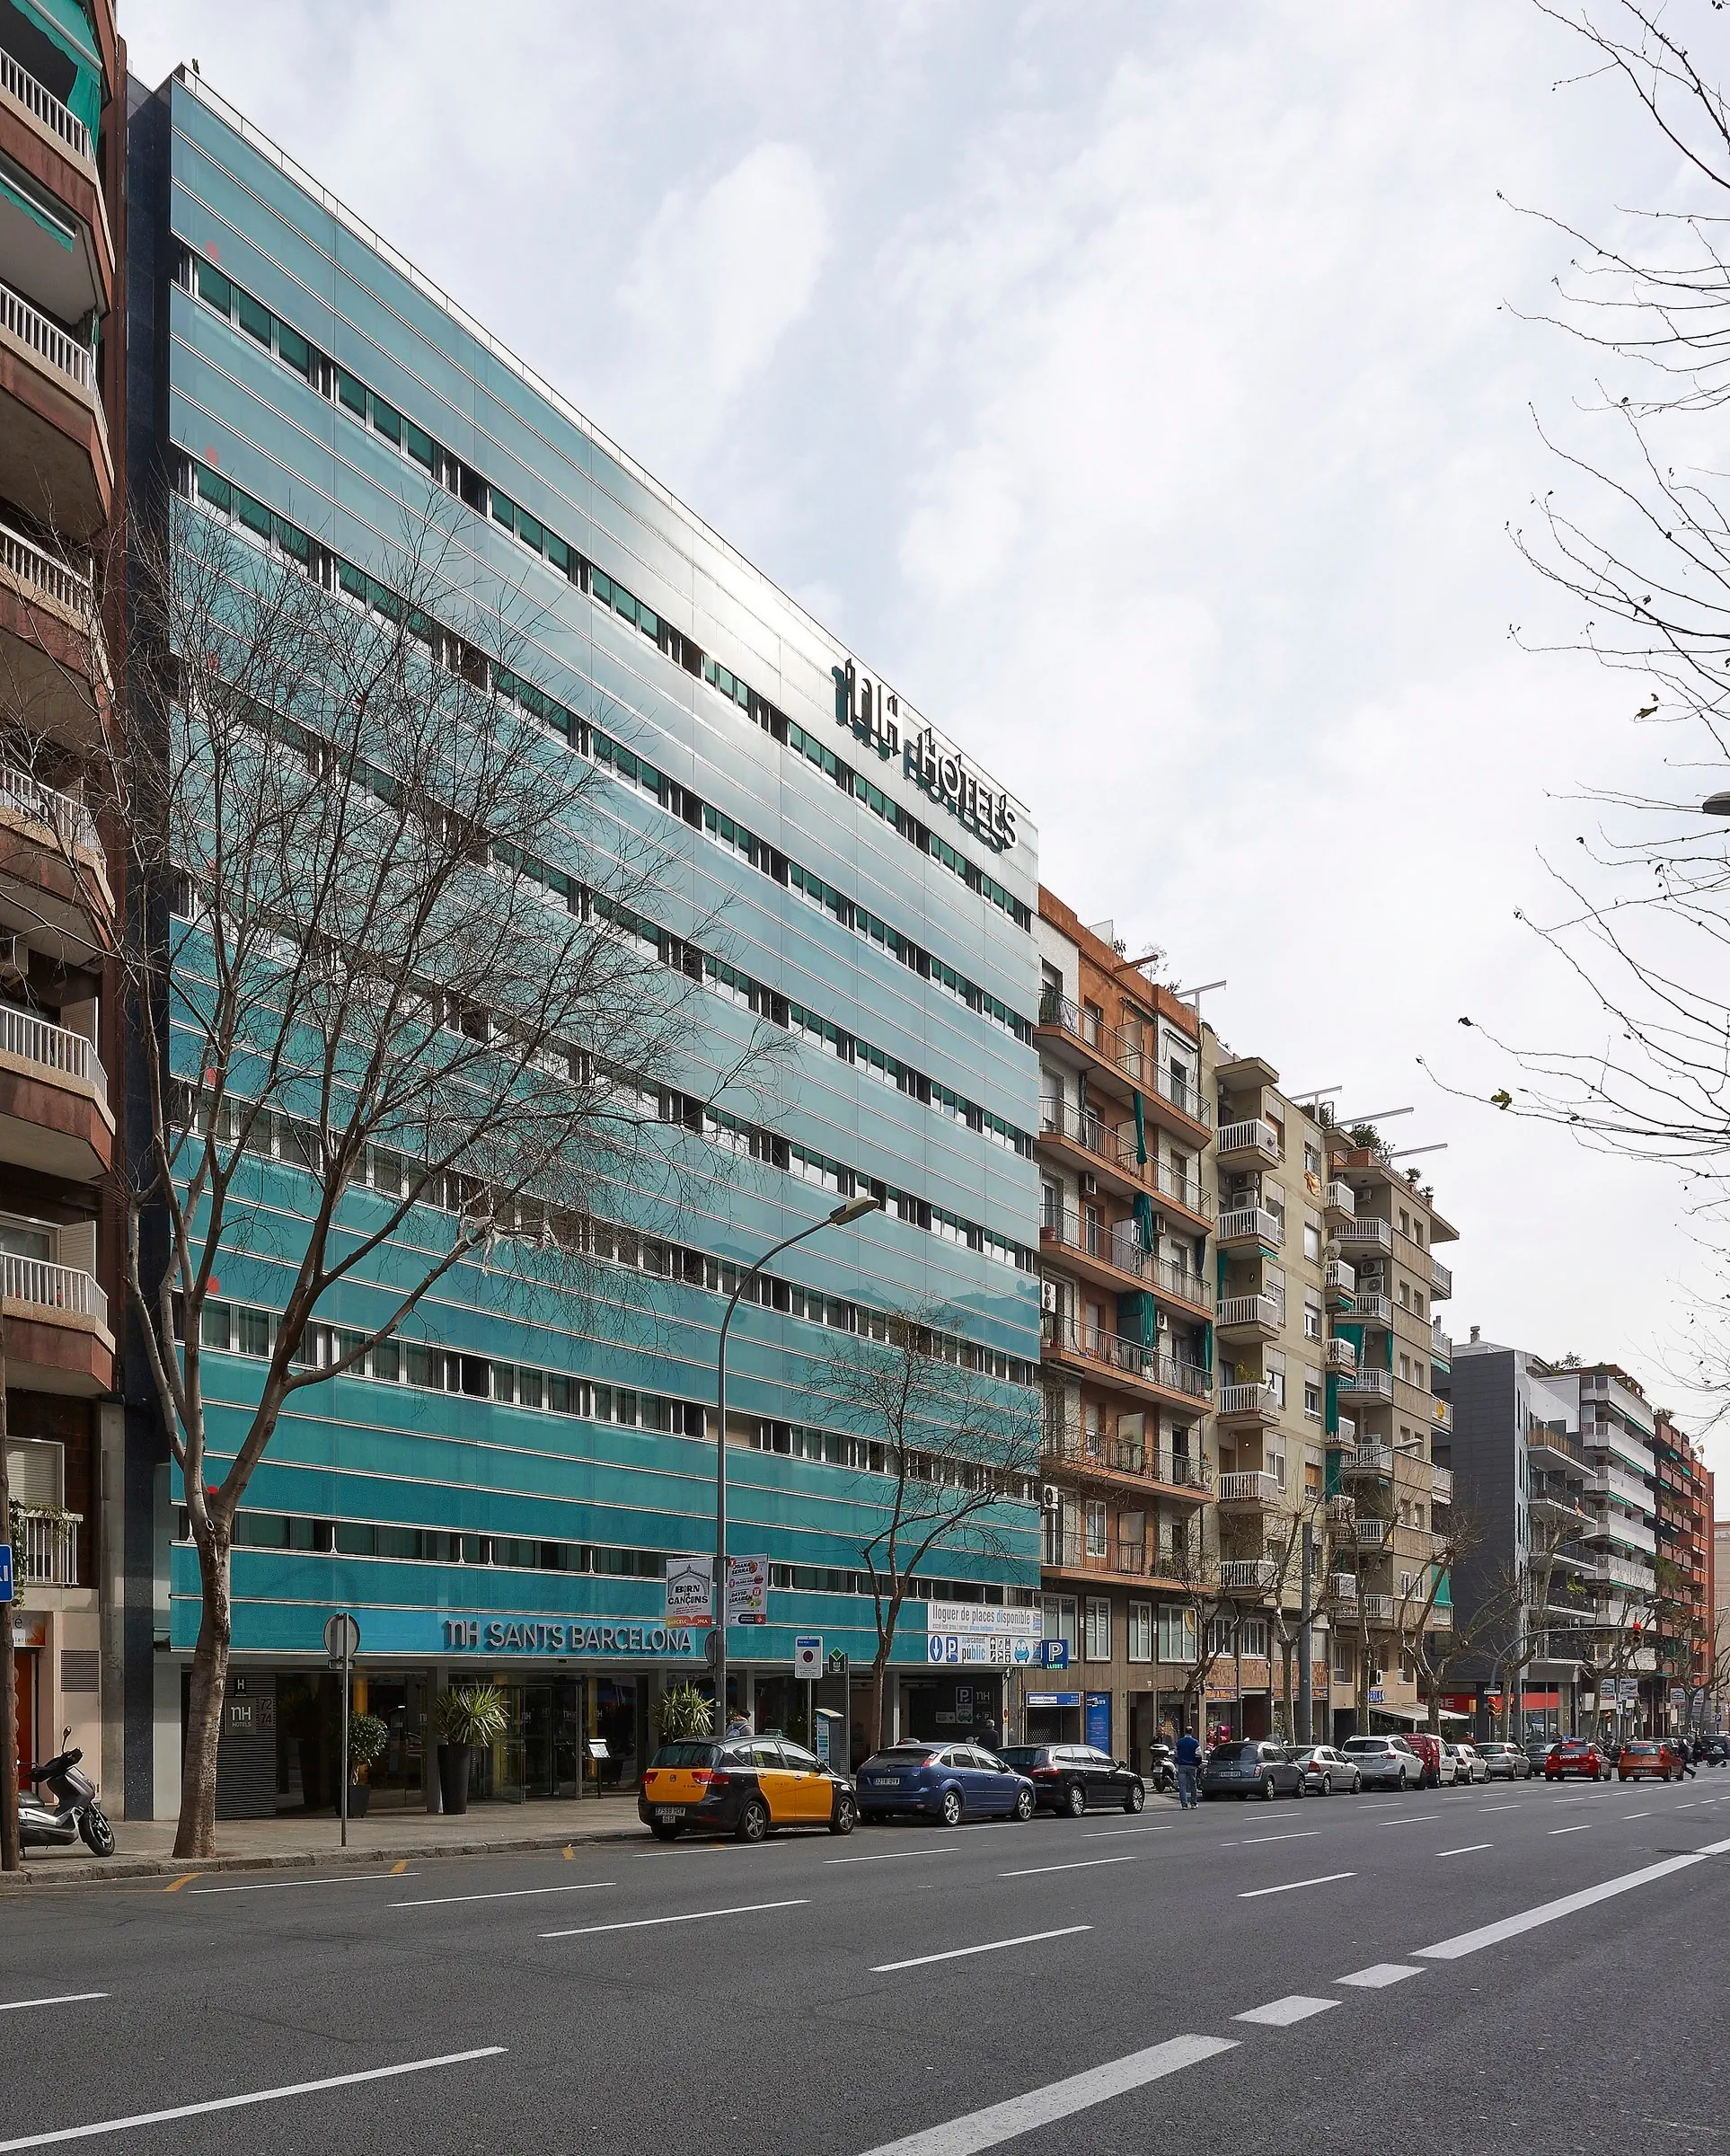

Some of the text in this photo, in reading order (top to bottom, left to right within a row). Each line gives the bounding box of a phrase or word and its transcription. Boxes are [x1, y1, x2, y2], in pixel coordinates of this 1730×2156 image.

[917, 727, 1019, 849] HOTELS
[675, 1585, 701, 1593] BORN
[667, 1595, 709, 1605] CANÇONS
[932, 1604, 1030, 1627] lloguer de places disponible
[490, 1621, 564, 1648] SANTS
[569, 1624, 692, 1651] BARCELONA
[962, 1644, 985, 1663] públic
[1048, 1642, 1064, 1662] P
[237, 1679, 244, 1689] H
[960, 1690, 969, 1701] P
[260, 1699, 272, 1710] 72
[260, 1713, 272, 1725] 74
